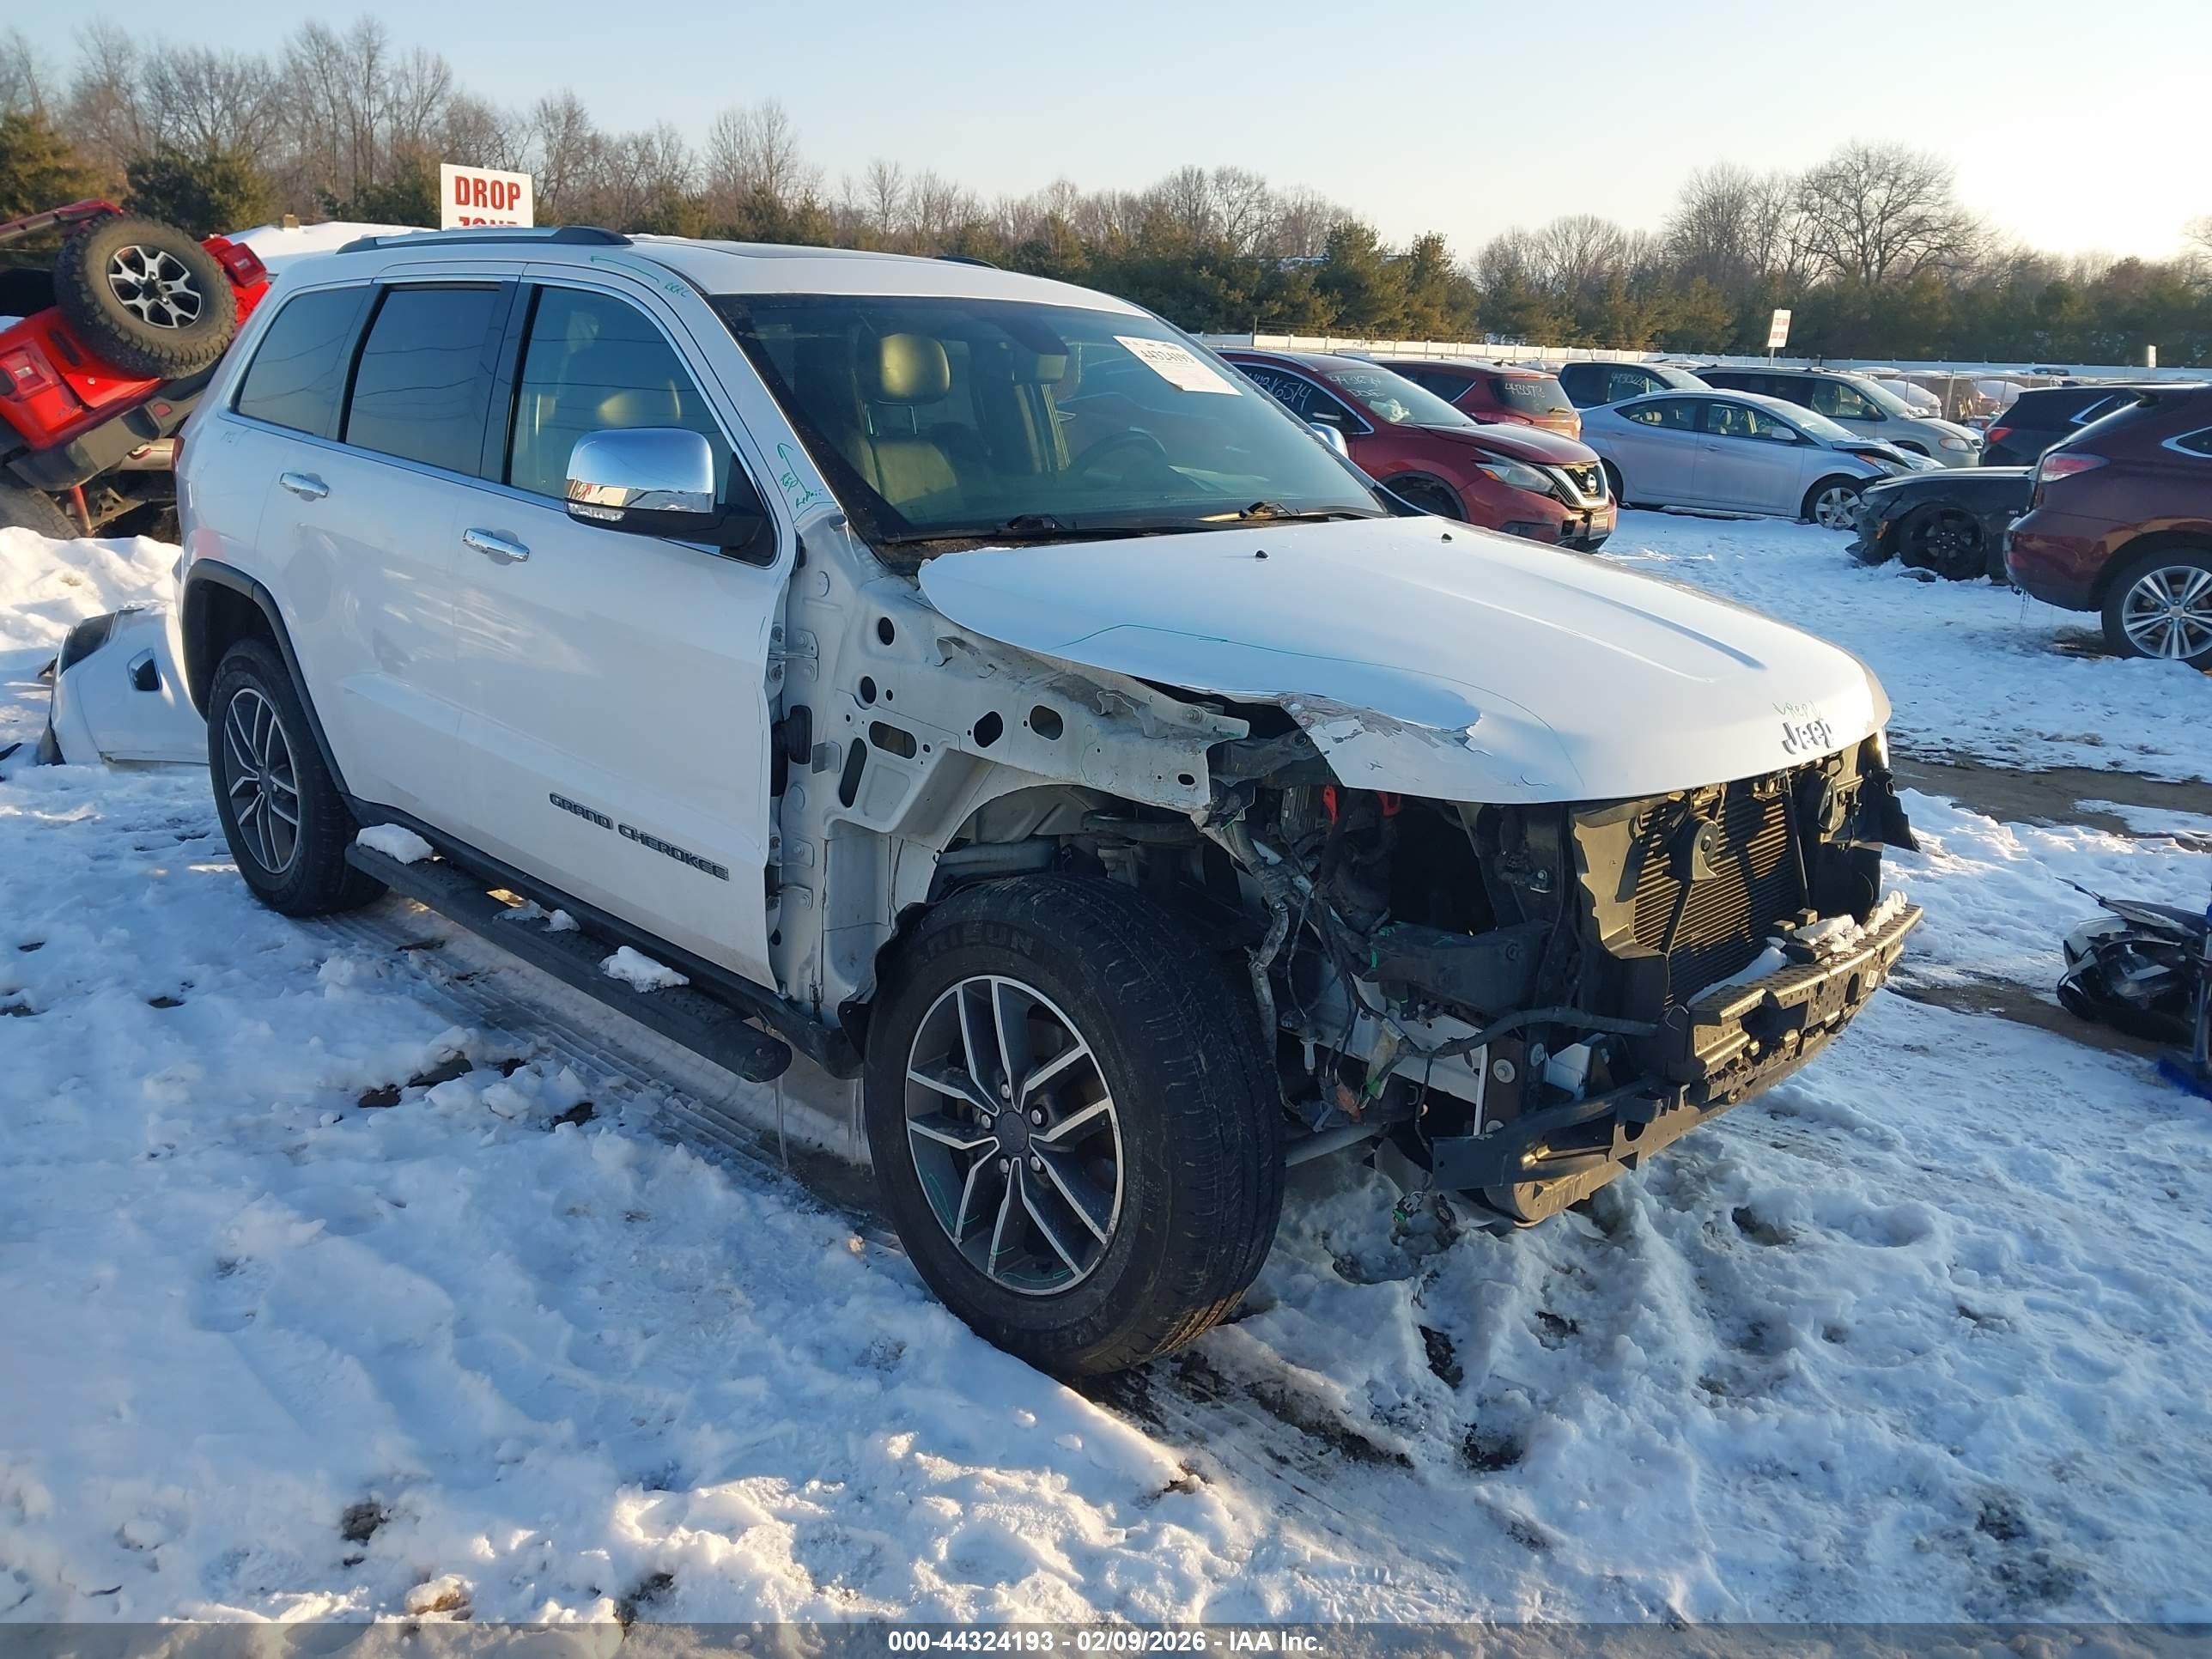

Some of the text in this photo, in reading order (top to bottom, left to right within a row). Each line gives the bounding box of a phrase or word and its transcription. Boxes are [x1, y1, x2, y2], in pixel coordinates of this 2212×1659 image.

[454, 176, 520, 210] DROP
[1781, 720, 1834, 755] Jeep
[549, 791, 730, 881] GRAND CHEROKEE
